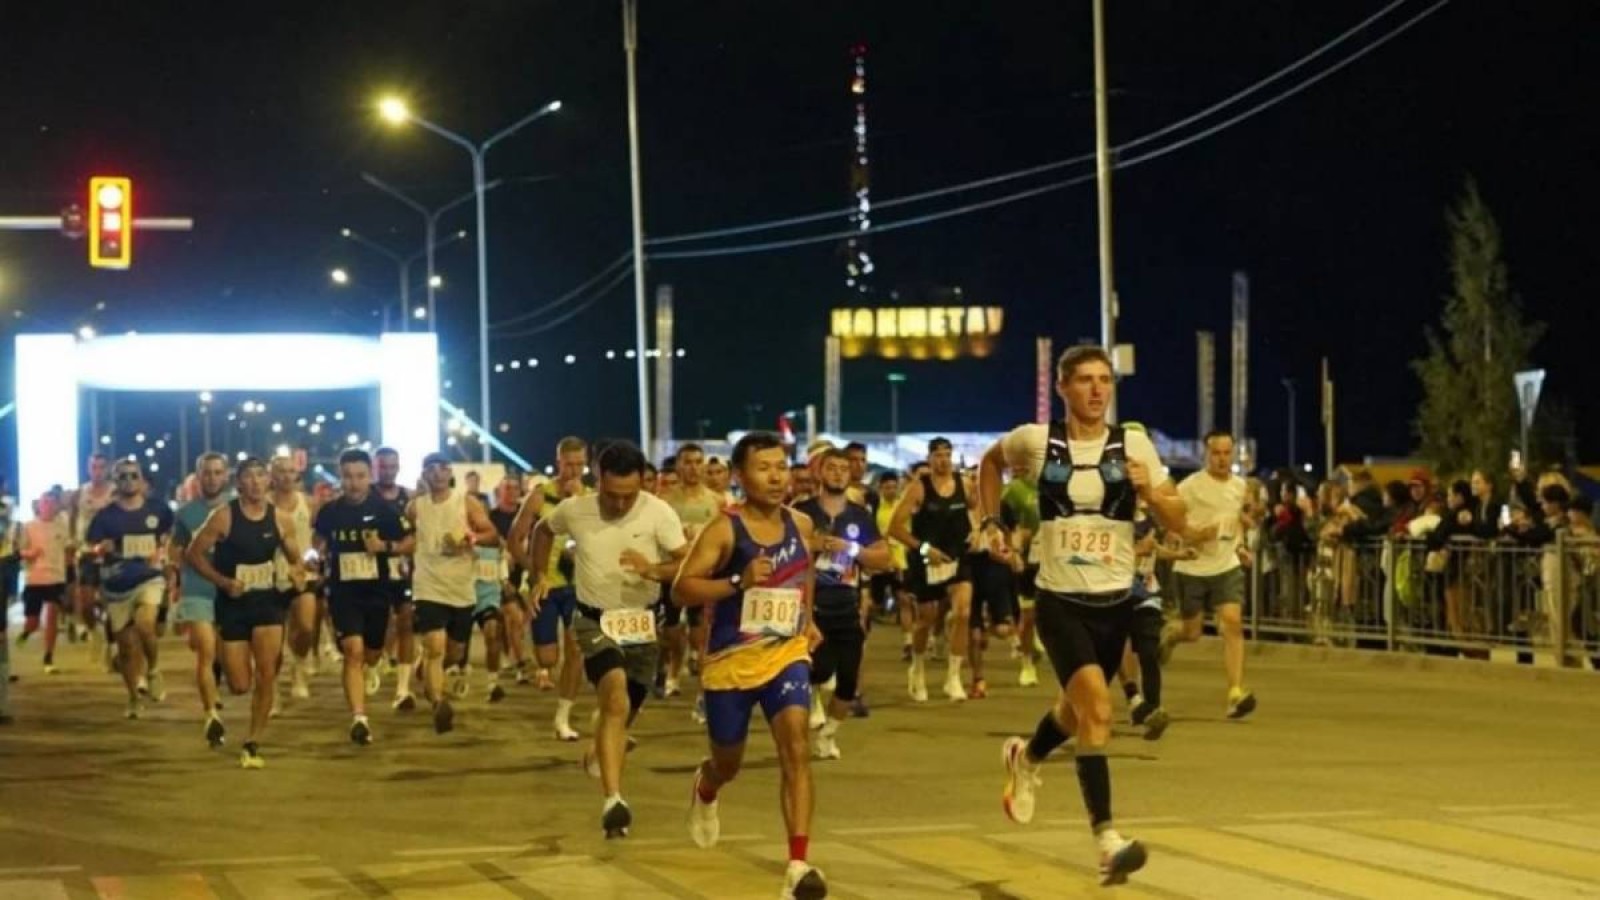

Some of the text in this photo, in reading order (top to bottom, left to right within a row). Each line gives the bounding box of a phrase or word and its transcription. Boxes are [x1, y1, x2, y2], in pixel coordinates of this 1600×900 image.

[1060, 529, 1111, 552] 1329
[750, 599, 797, 623] 1302
[605, 614, 650, 635] 1238
